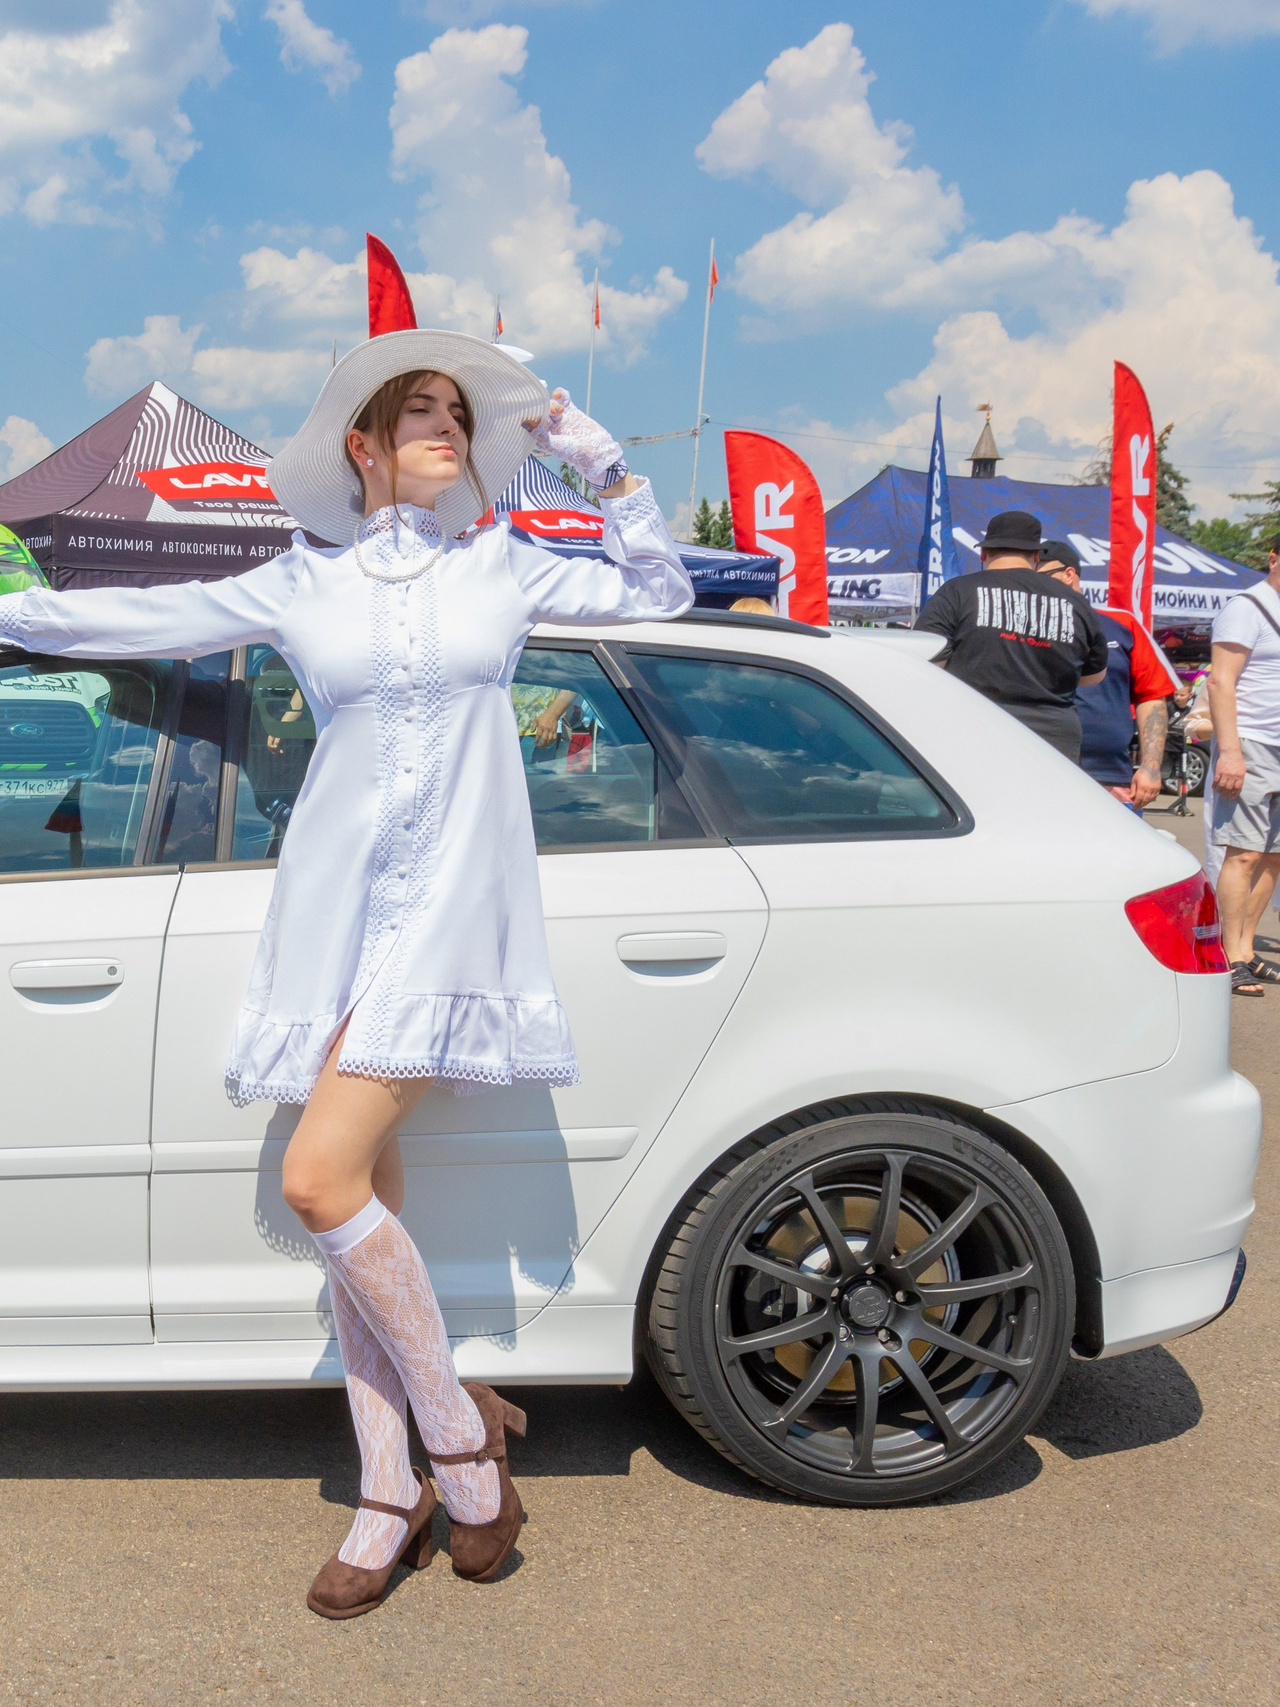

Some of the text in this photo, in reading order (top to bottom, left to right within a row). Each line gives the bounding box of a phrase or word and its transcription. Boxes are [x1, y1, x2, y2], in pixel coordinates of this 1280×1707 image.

[530, 518, 604, 530] LAV
[68, 535, 153, 552] АВТОХИМИЯ
[162, 541, 243, 557] АВТОКОСМЕТИКА
[723, 570, 776, 582] АВТОХИМИЯ
[1155, 589, 1207, 610] МОЙКИ
[976, 1149, 1045, 1228] MICHELIN
